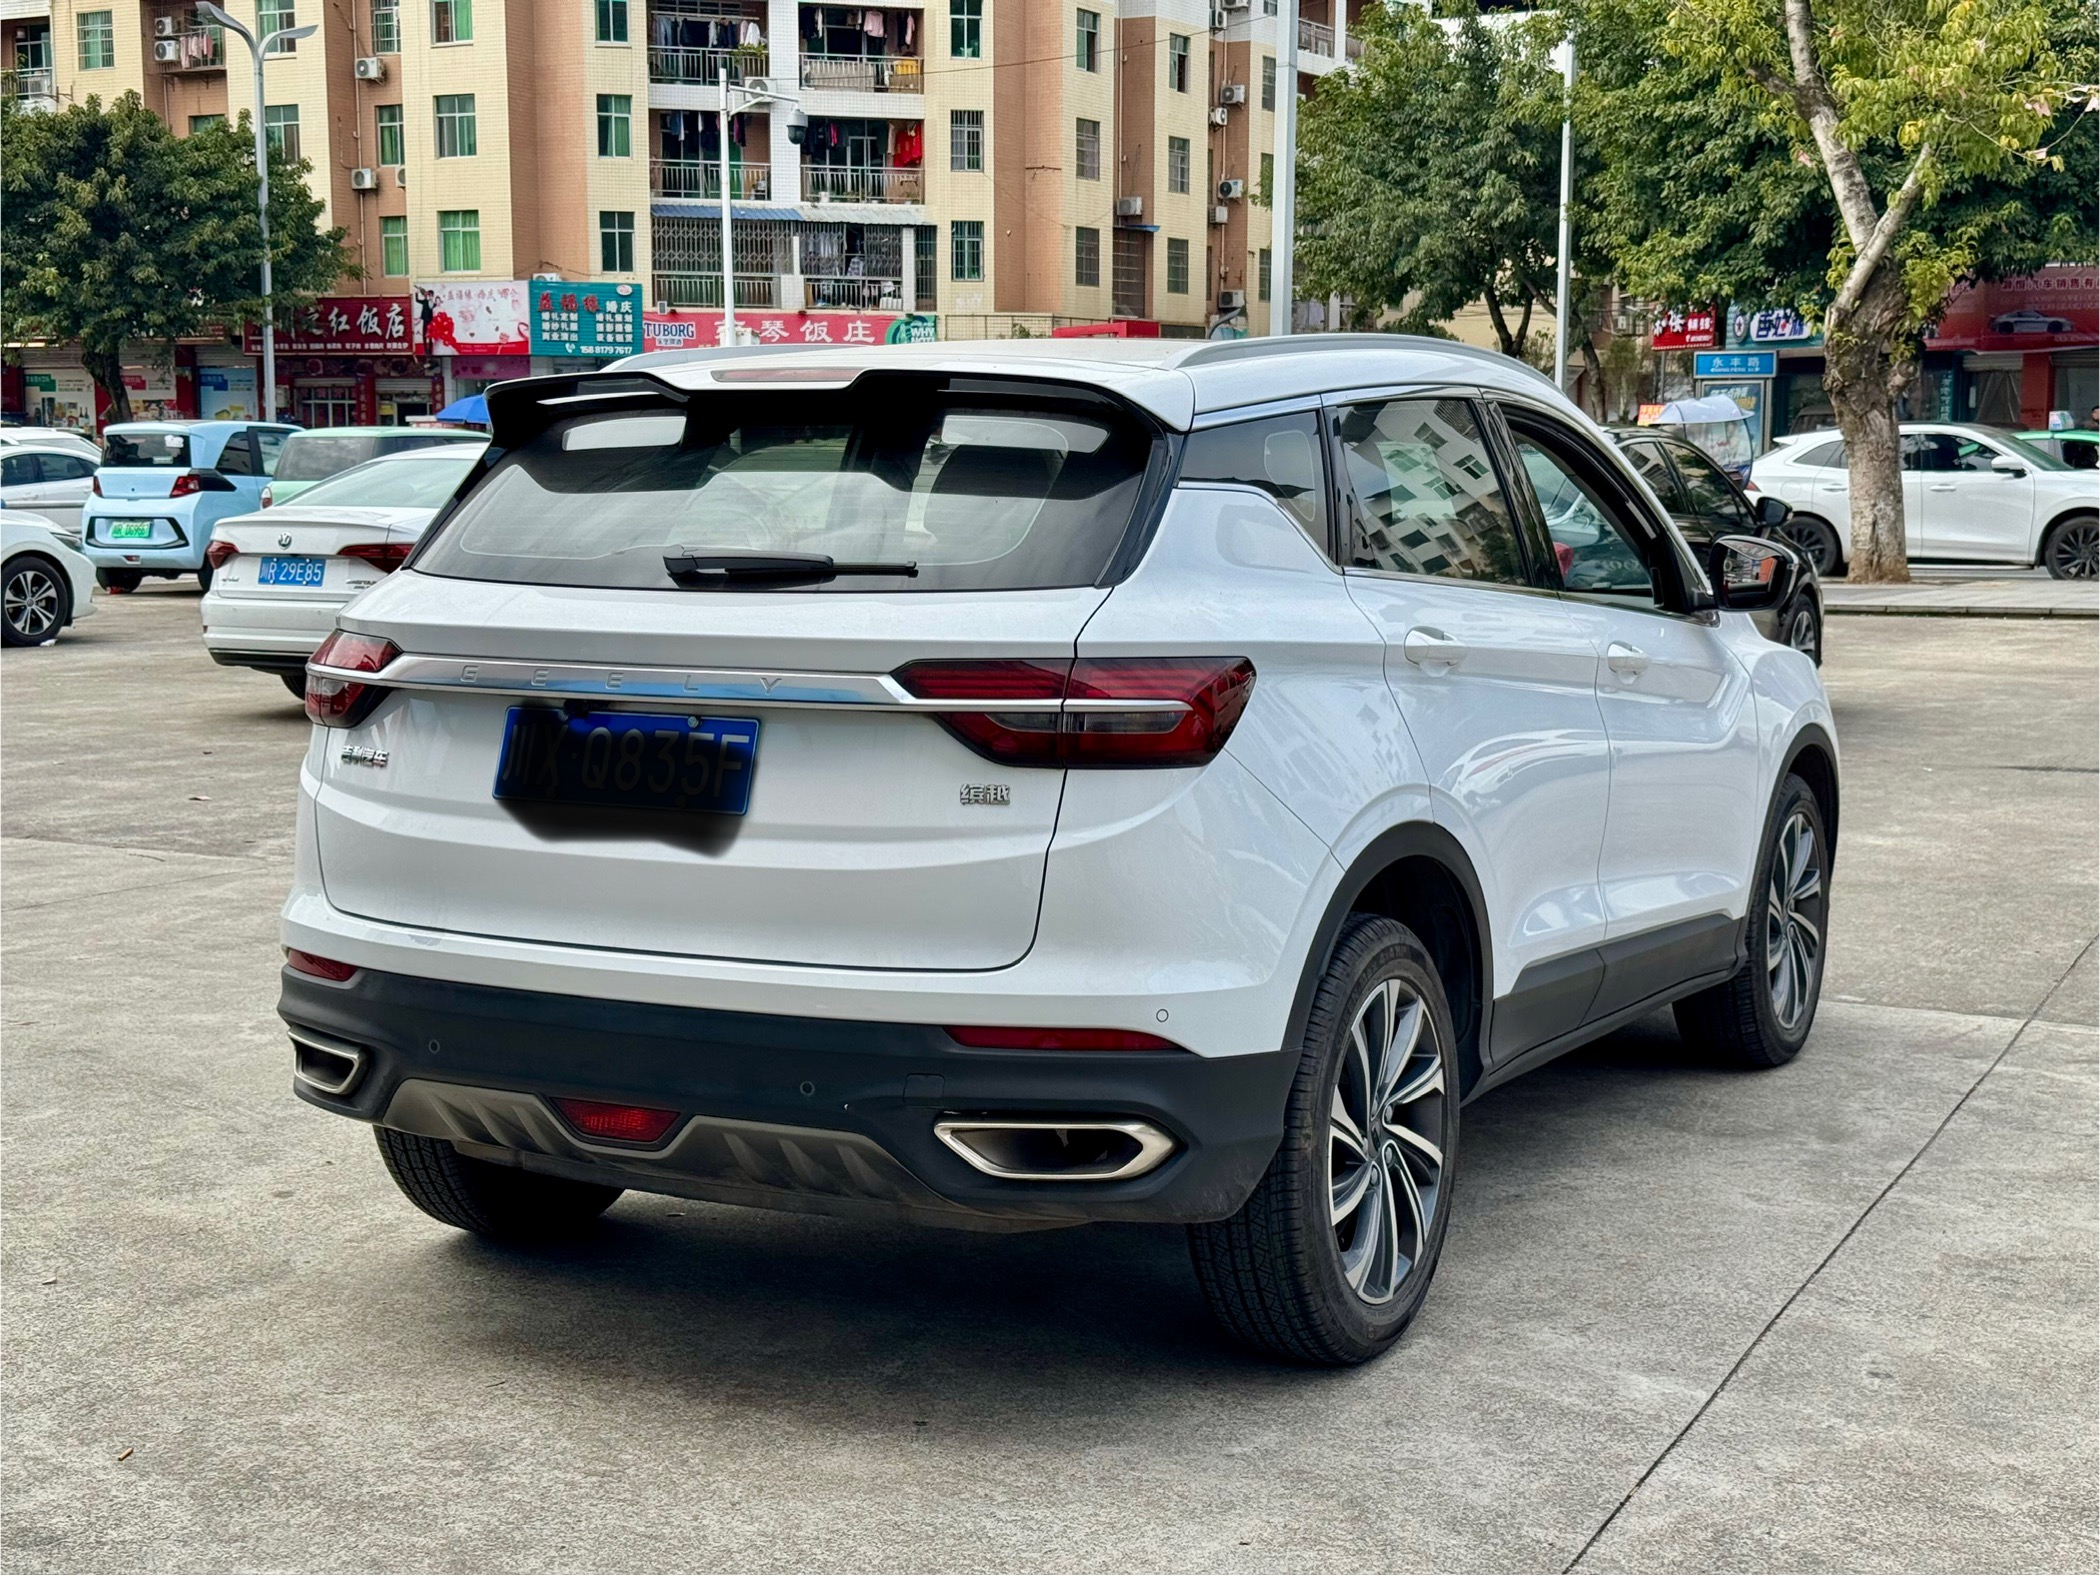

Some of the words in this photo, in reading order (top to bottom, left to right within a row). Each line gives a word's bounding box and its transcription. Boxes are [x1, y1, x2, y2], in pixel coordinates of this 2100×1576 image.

[606, 301, 632, 313] 婚庆
[644, 322, 694, 338] TUBORG
[910, 328, 935, 337] WHY
[1712, 357, 1760, 368] 永丰路
[460, 664, 782, 696] GEELY
[960, 783, 1010, 805] 缤越
